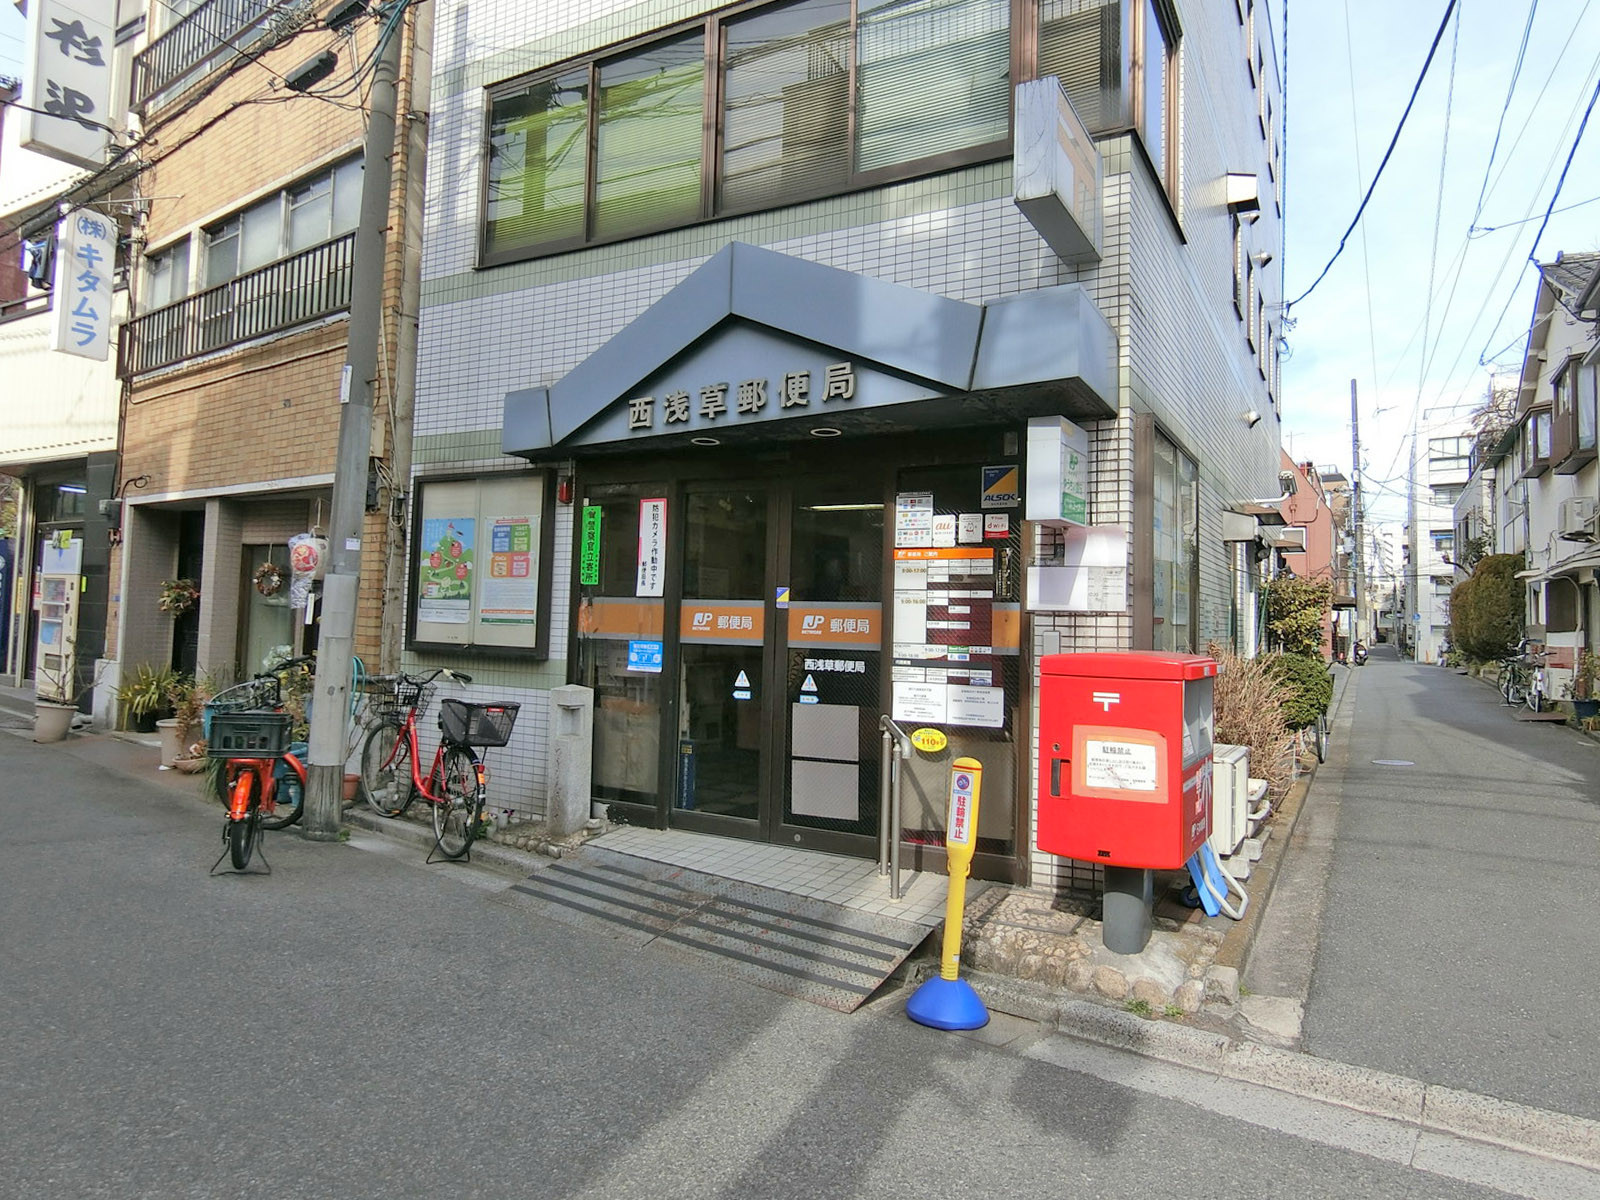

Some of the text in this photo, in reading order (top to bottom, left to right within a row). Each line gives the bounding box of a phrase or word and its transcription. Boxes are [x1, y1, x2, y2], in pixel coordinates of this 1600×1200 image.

[628, 361, 857, 430] 西浅草郵便局
[983, 493, 1016, 502] ALSOK
[935, 522, 953, 531] au
[650, 504, 661, 590] 防犯カメラ作動中です
[692, 612, 713, 626] JP
[717, 615, 753, 631] 郵便局
[802, 615, 825, 629] JP
[829, 618, 870, 634] 郵便局
[804, 658, 866, 674] 西浅草郵便局
[954, 795, 966, 840] 駐輪禁止
